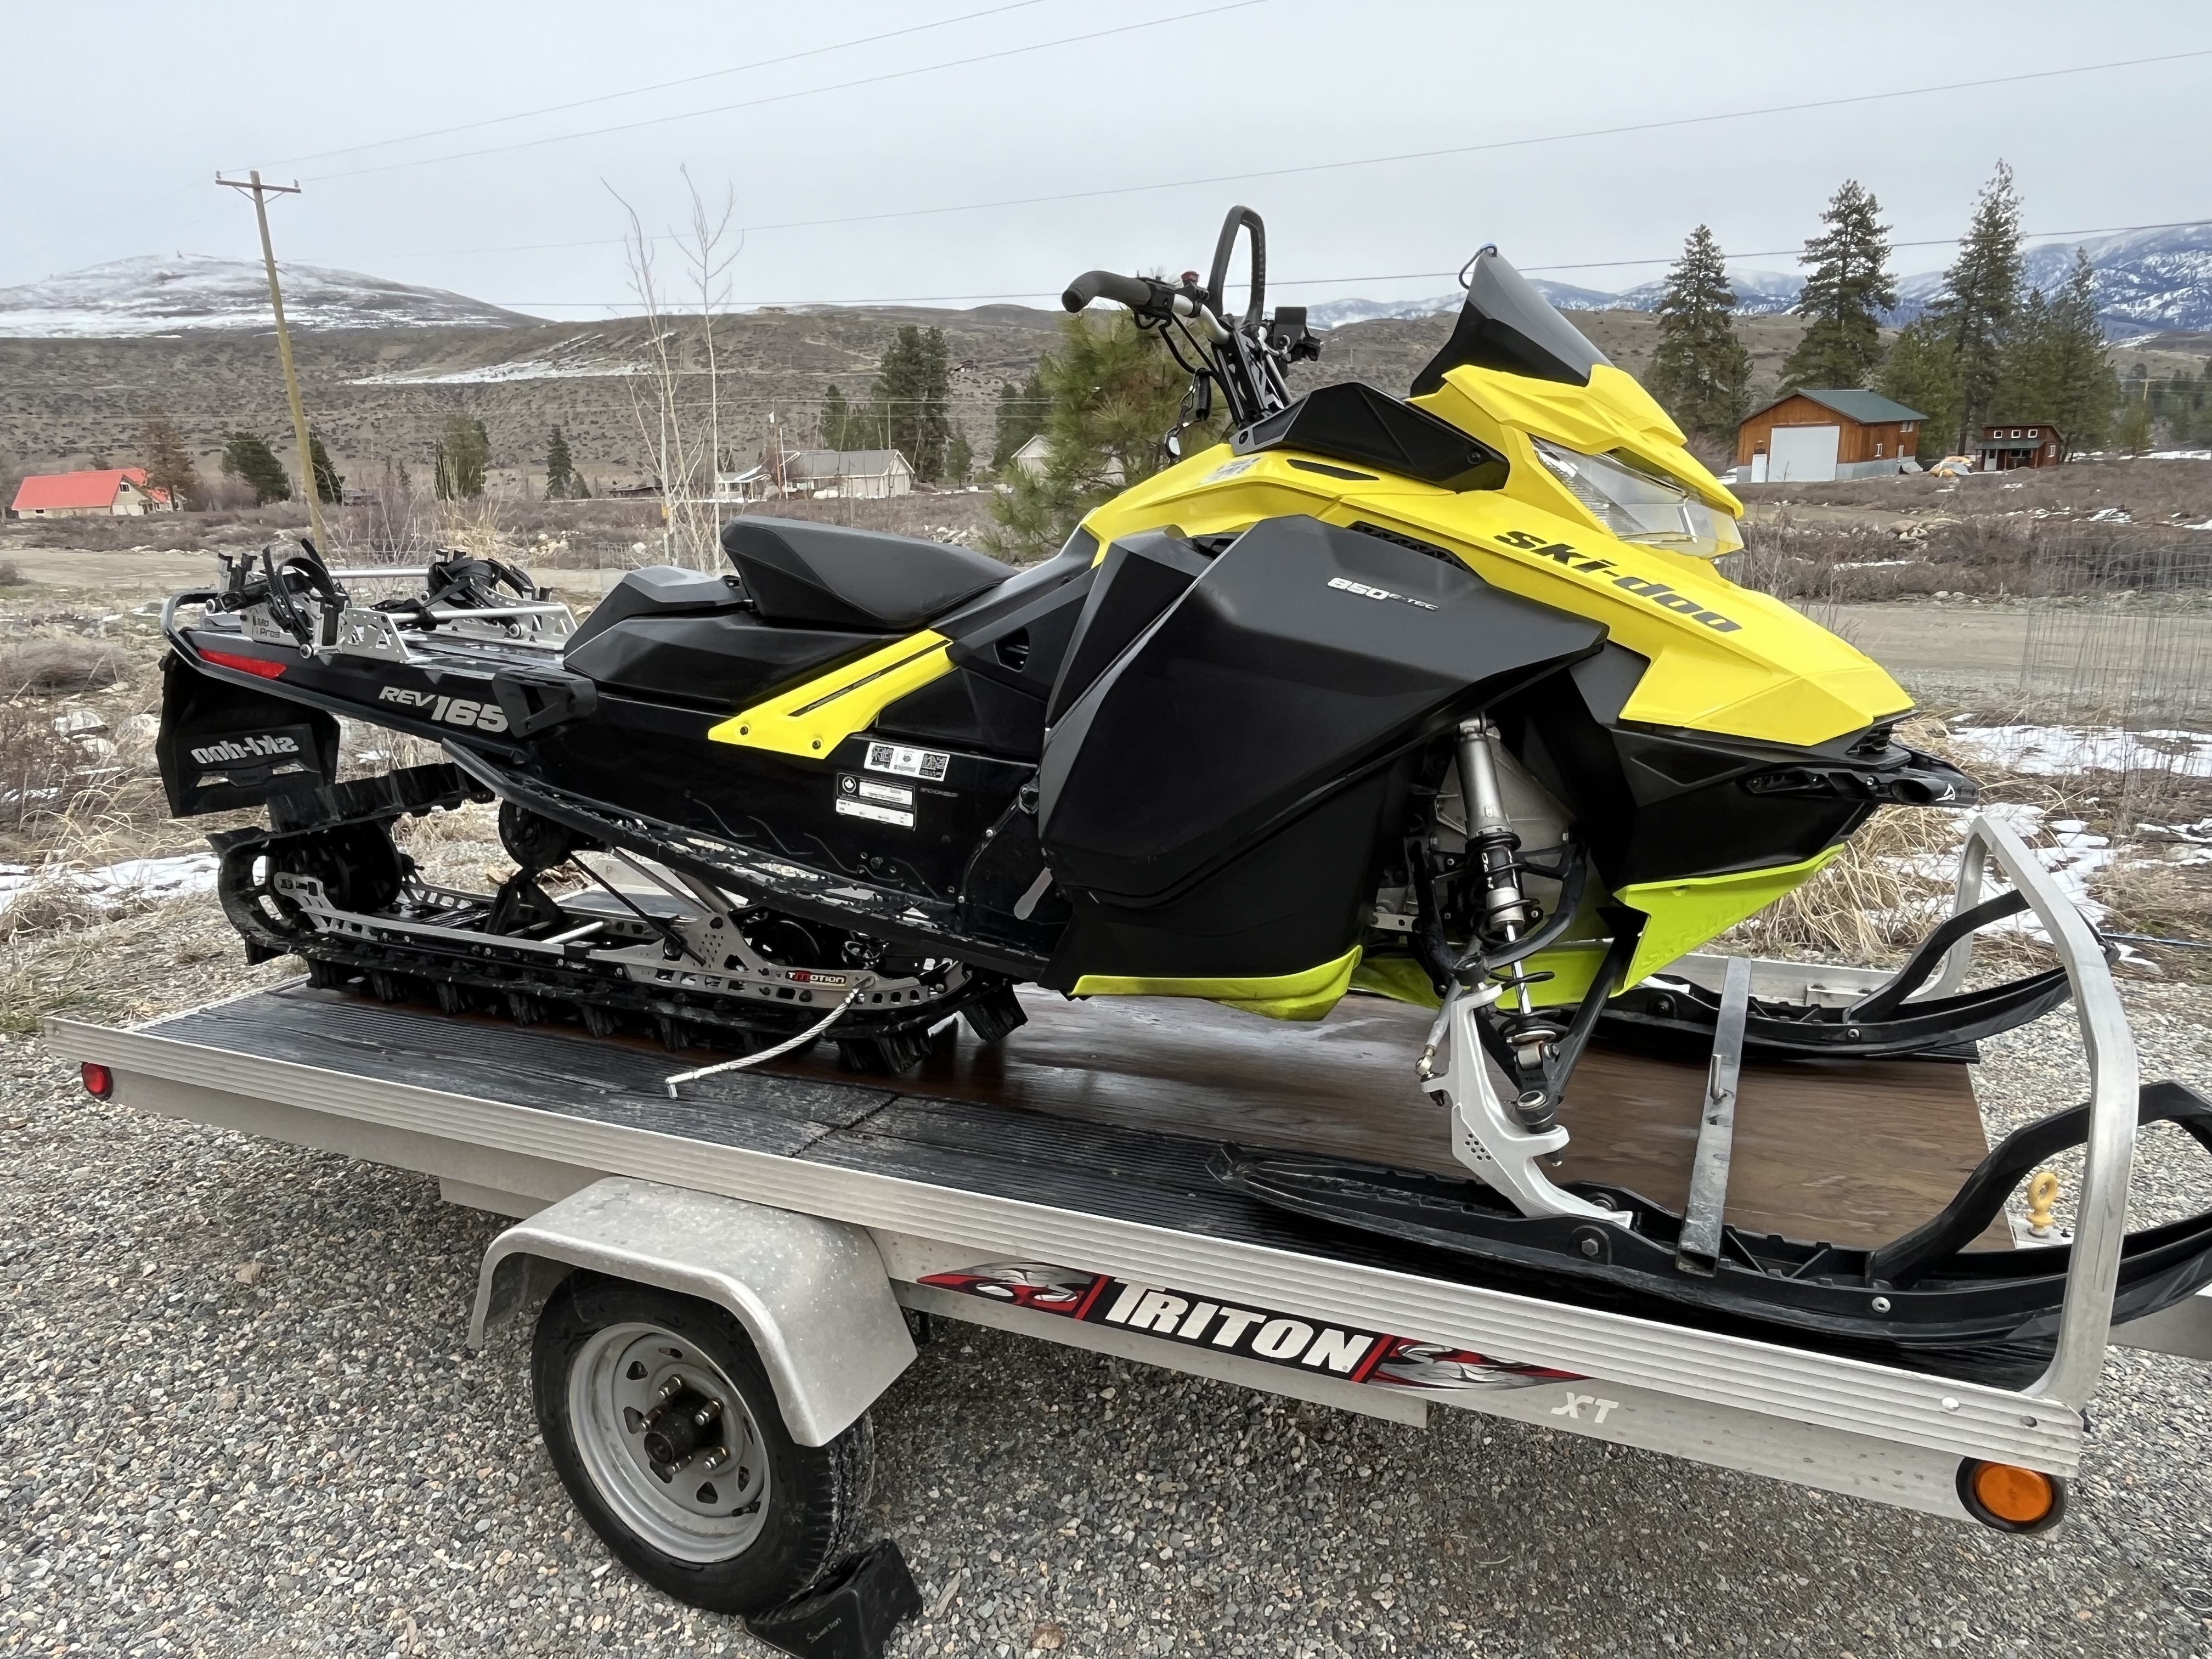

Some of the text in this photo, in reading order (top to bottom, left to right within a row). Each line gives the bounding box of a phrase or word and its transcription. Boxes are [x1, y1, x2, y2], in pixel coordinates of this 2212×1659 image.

[1493, 531, 1742, 633] ski-doo
[379, 686, 509, 732] REV 165
[1105, 1277, 1374, 1374] TRITON
[1550, 1391, 1620, 1424] XT
